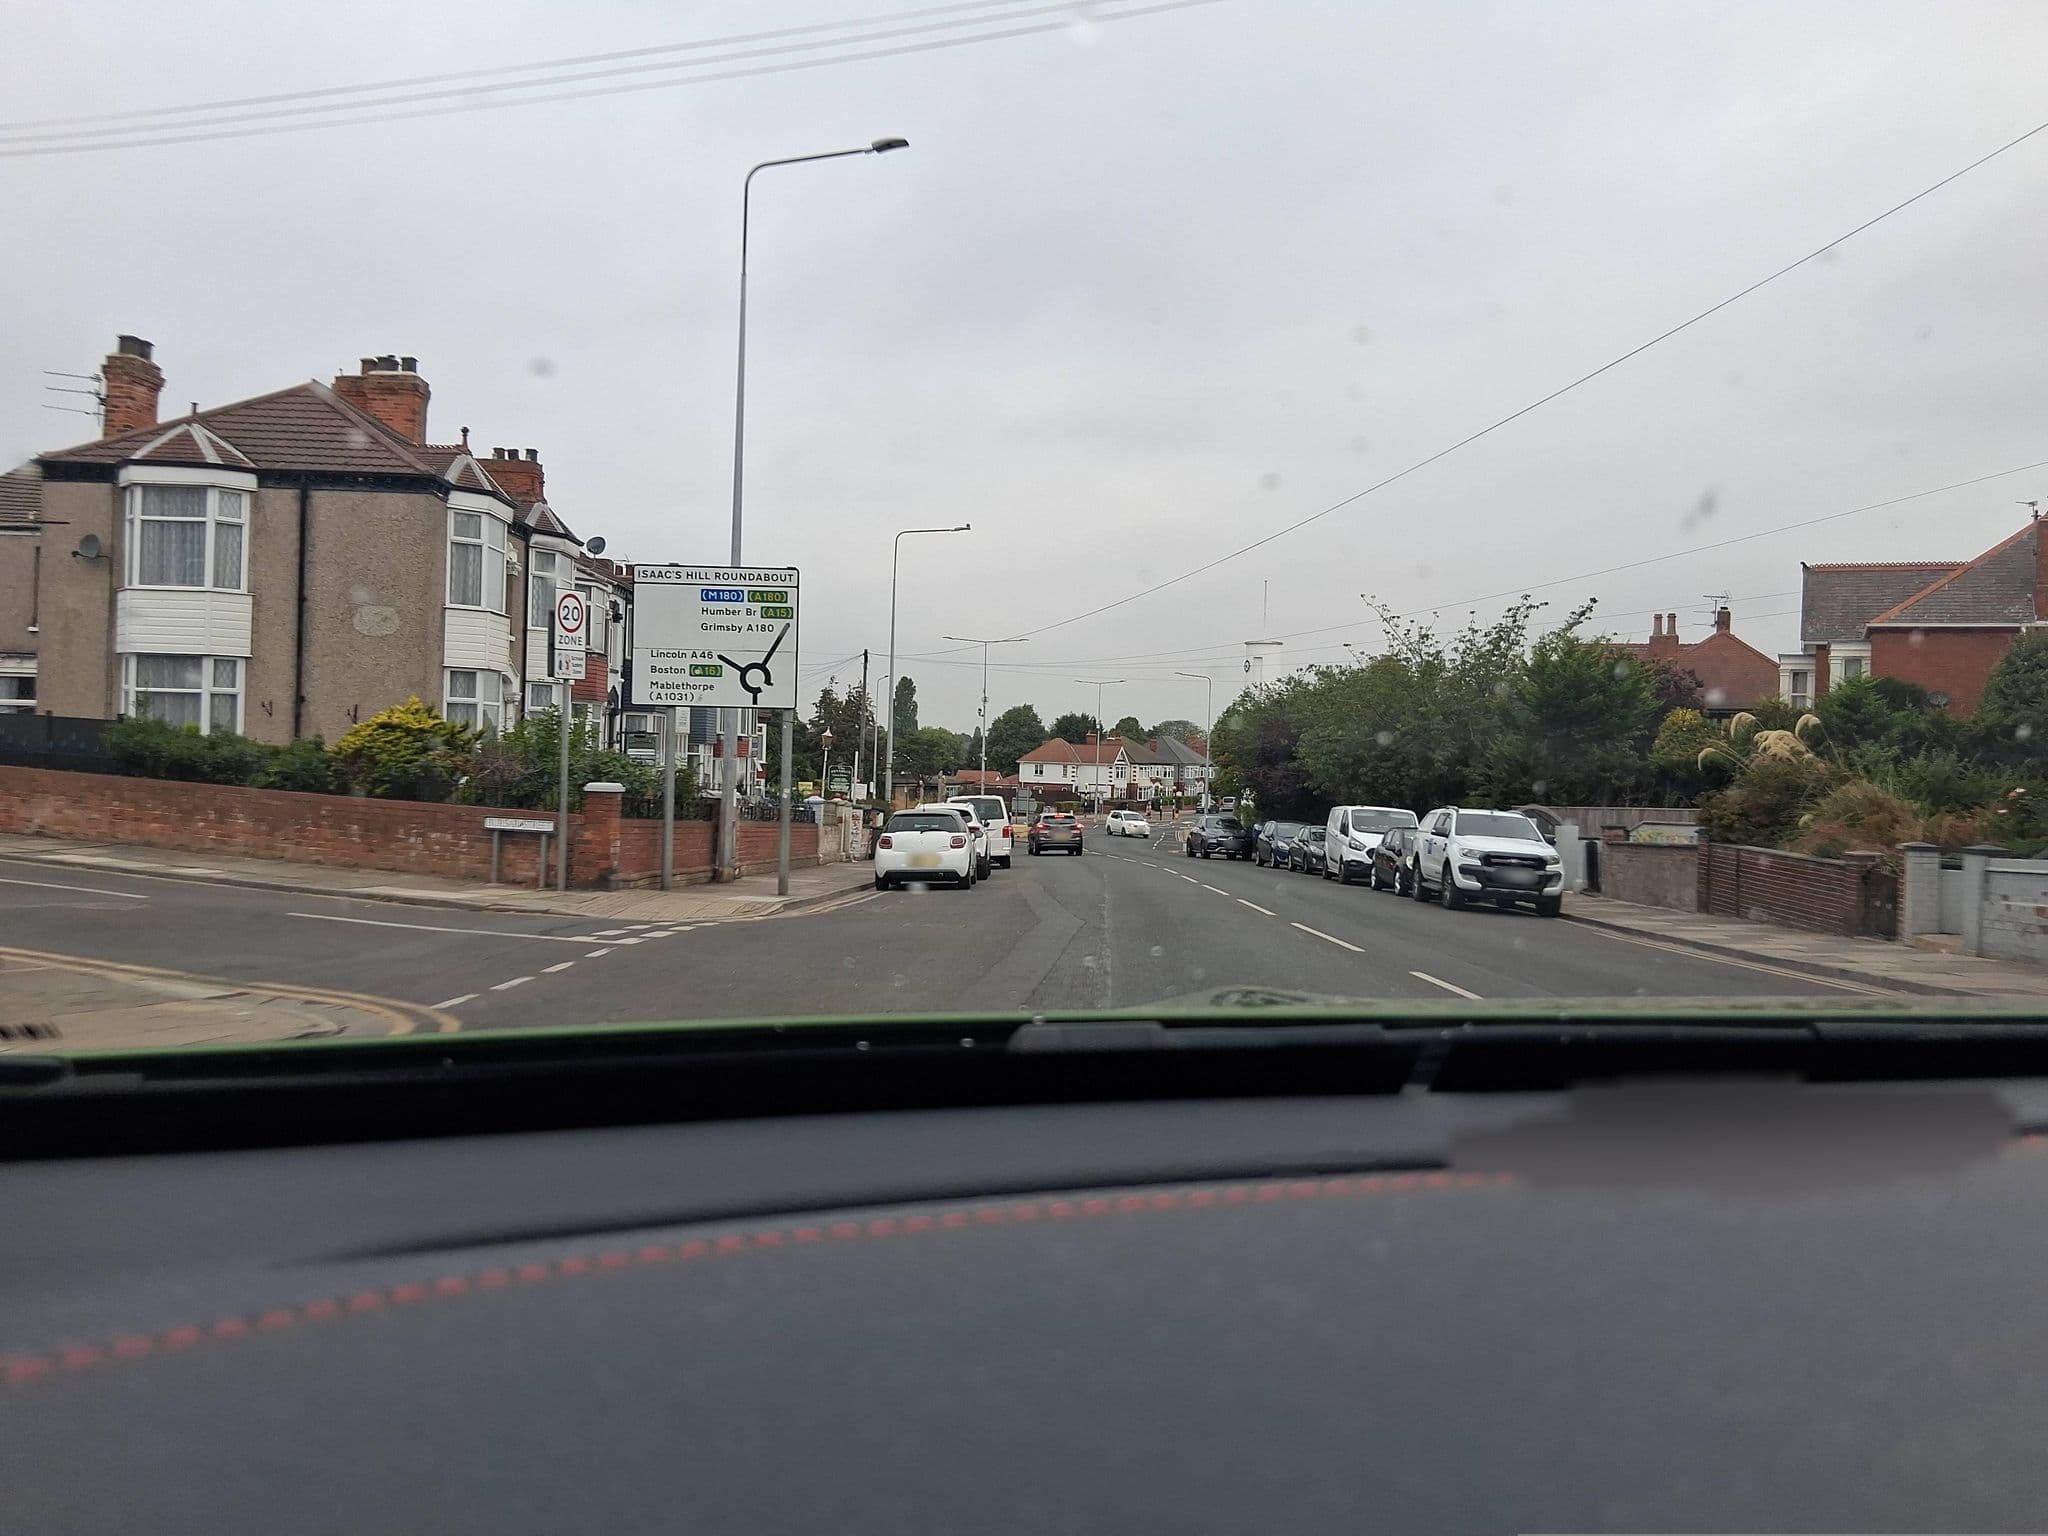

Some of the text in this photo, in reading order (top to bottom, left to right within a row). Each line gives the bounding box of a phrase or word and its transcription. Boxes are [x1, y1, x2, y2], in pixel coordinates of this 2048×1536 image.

[638, 570, 794, 582] ISAAC'S HILL ROUNDABOUT
[702, 590, 787, 602] (M180) (A180)
[562, 605, 580, 622] 20
[701, 607, 793, 619] Humber Br (A15)
[701, 622, 774, 633] Grimsby A180
[558, 634, 583, 646] ZONE
[650, 650, 714, 660] Lincoln A46
[650, 666, 686, 675] Boston
[650, 681, 715, 691] Mablethorpe
[649, 692, 695, 702] (A1031)
